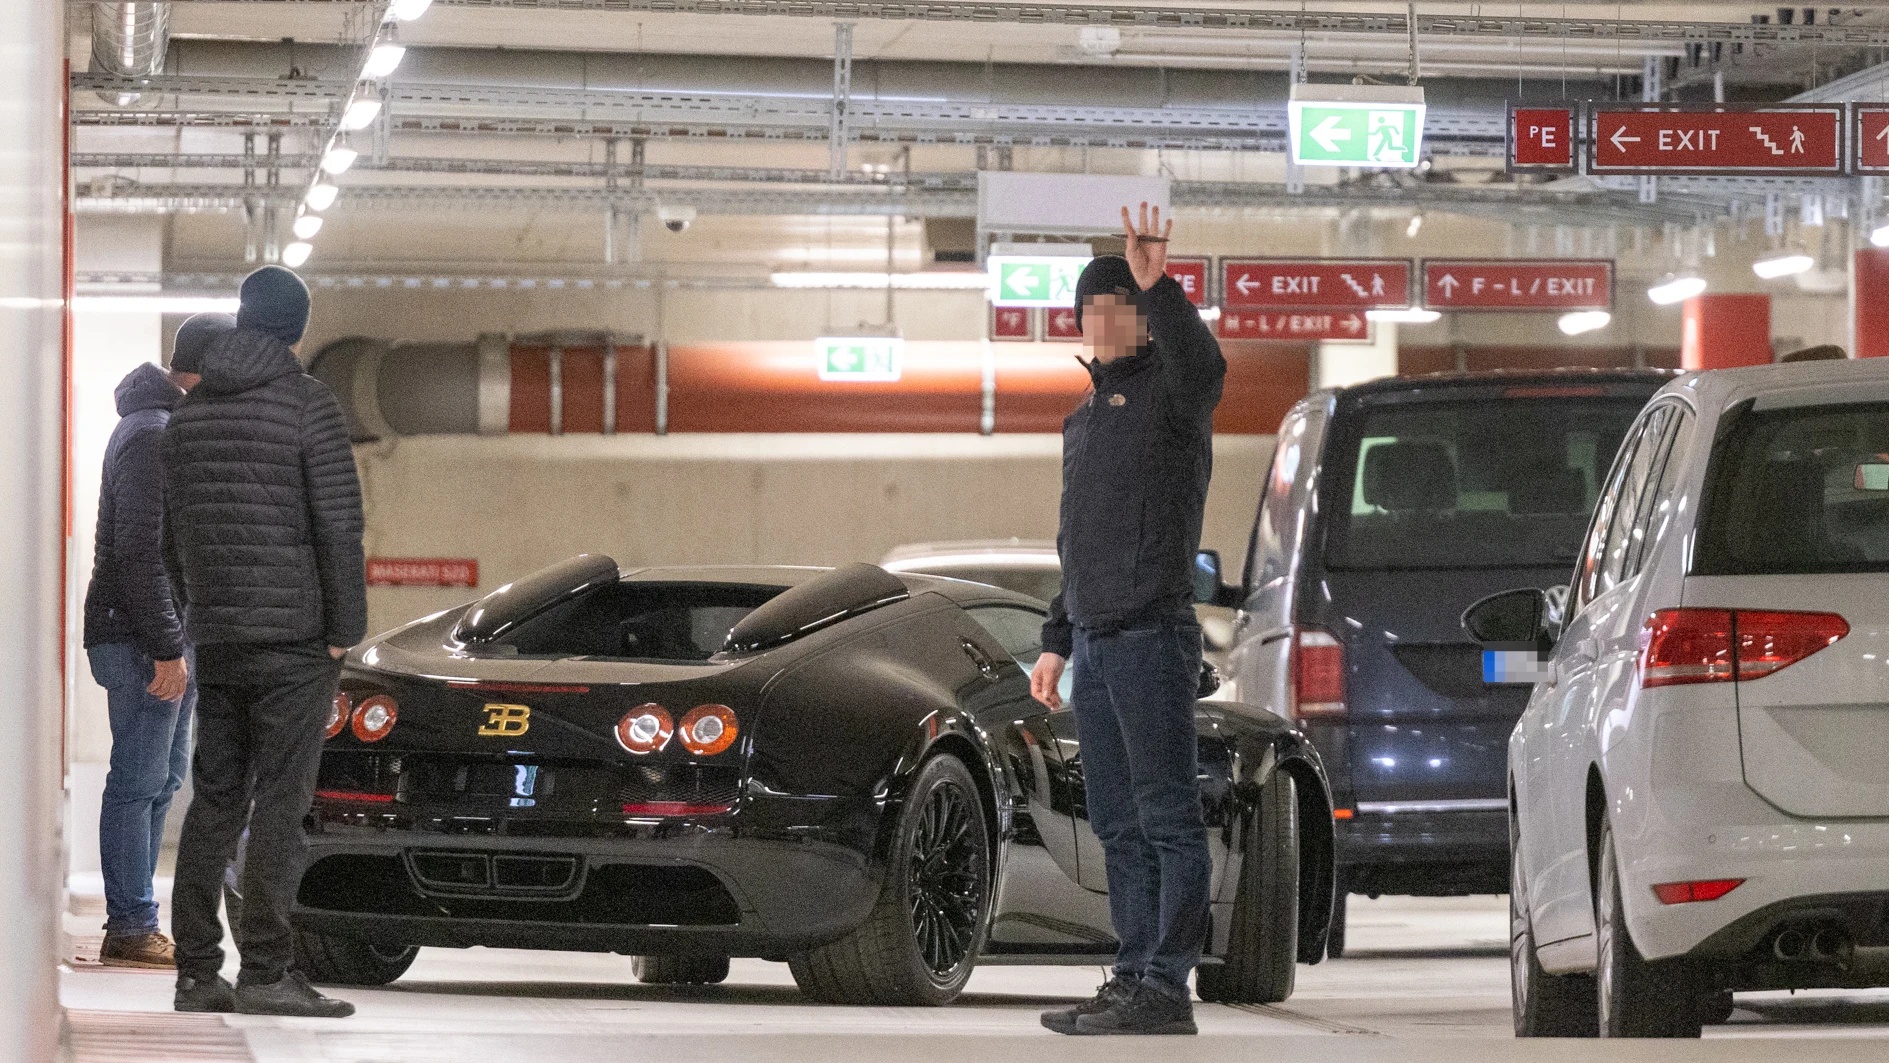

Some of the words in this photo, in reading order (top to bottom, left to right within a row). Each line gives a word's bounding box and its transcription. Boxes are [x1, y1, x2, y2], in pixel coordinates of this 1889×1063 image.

[1530, 125, 1556, 148] PE
[1658, 129, 1721, 151] EXIT
[1271, 275, 1321, 295] EXIT
[1546, 277, 1596, 297] EXIT
[1289, 315, 1333, 332] EXIT
